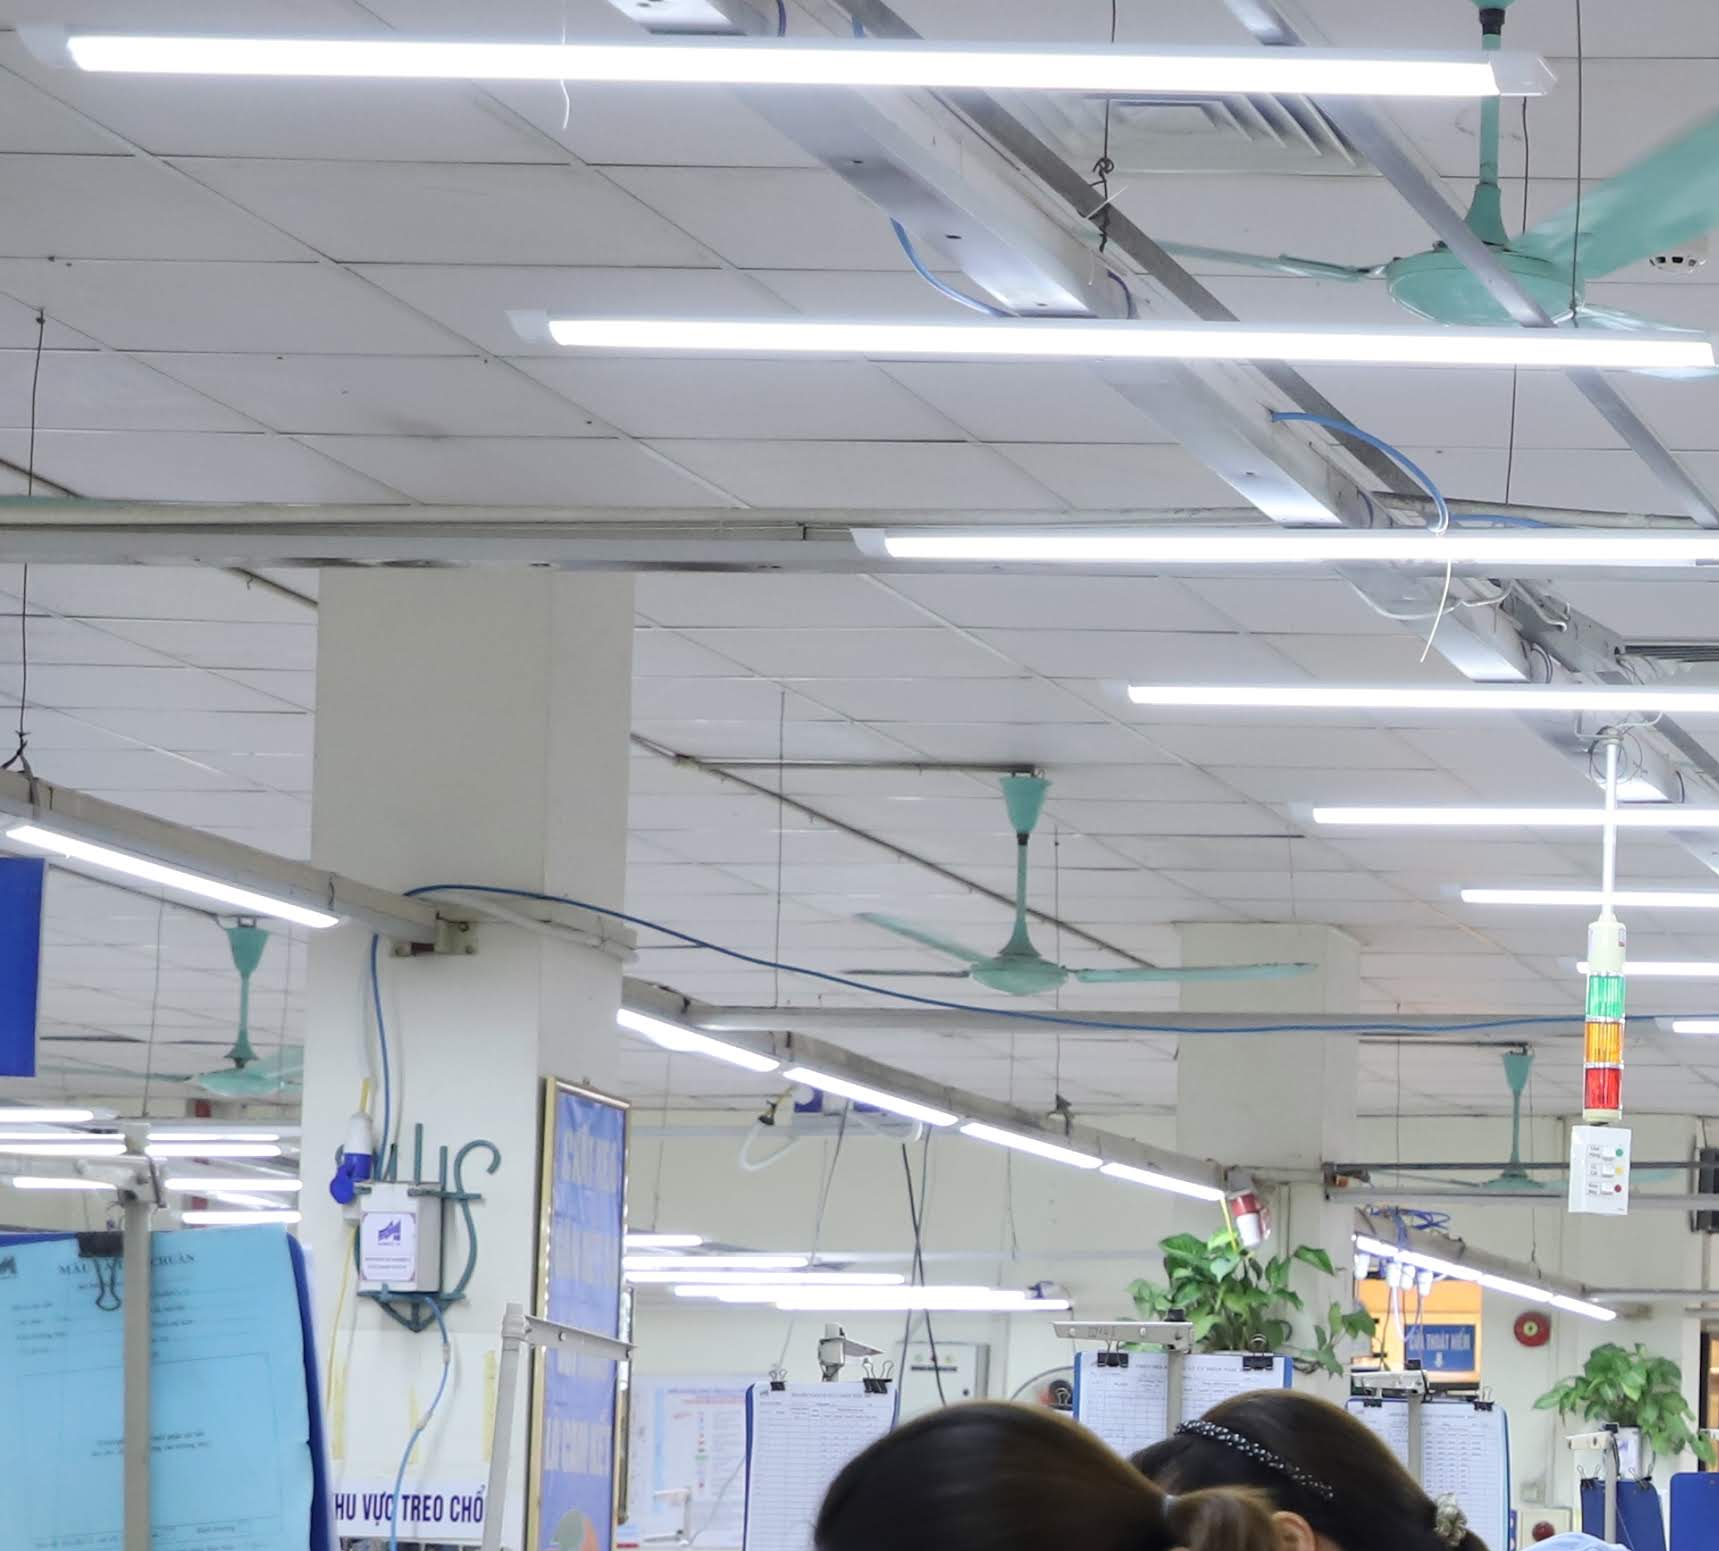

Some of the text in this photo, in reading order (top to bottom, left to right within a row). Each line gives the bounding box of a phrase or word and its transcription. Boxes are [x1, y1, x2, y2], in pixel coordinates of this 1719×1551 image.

[335, 1484, 486, 1527] HU VỰC TREO CHỔ
